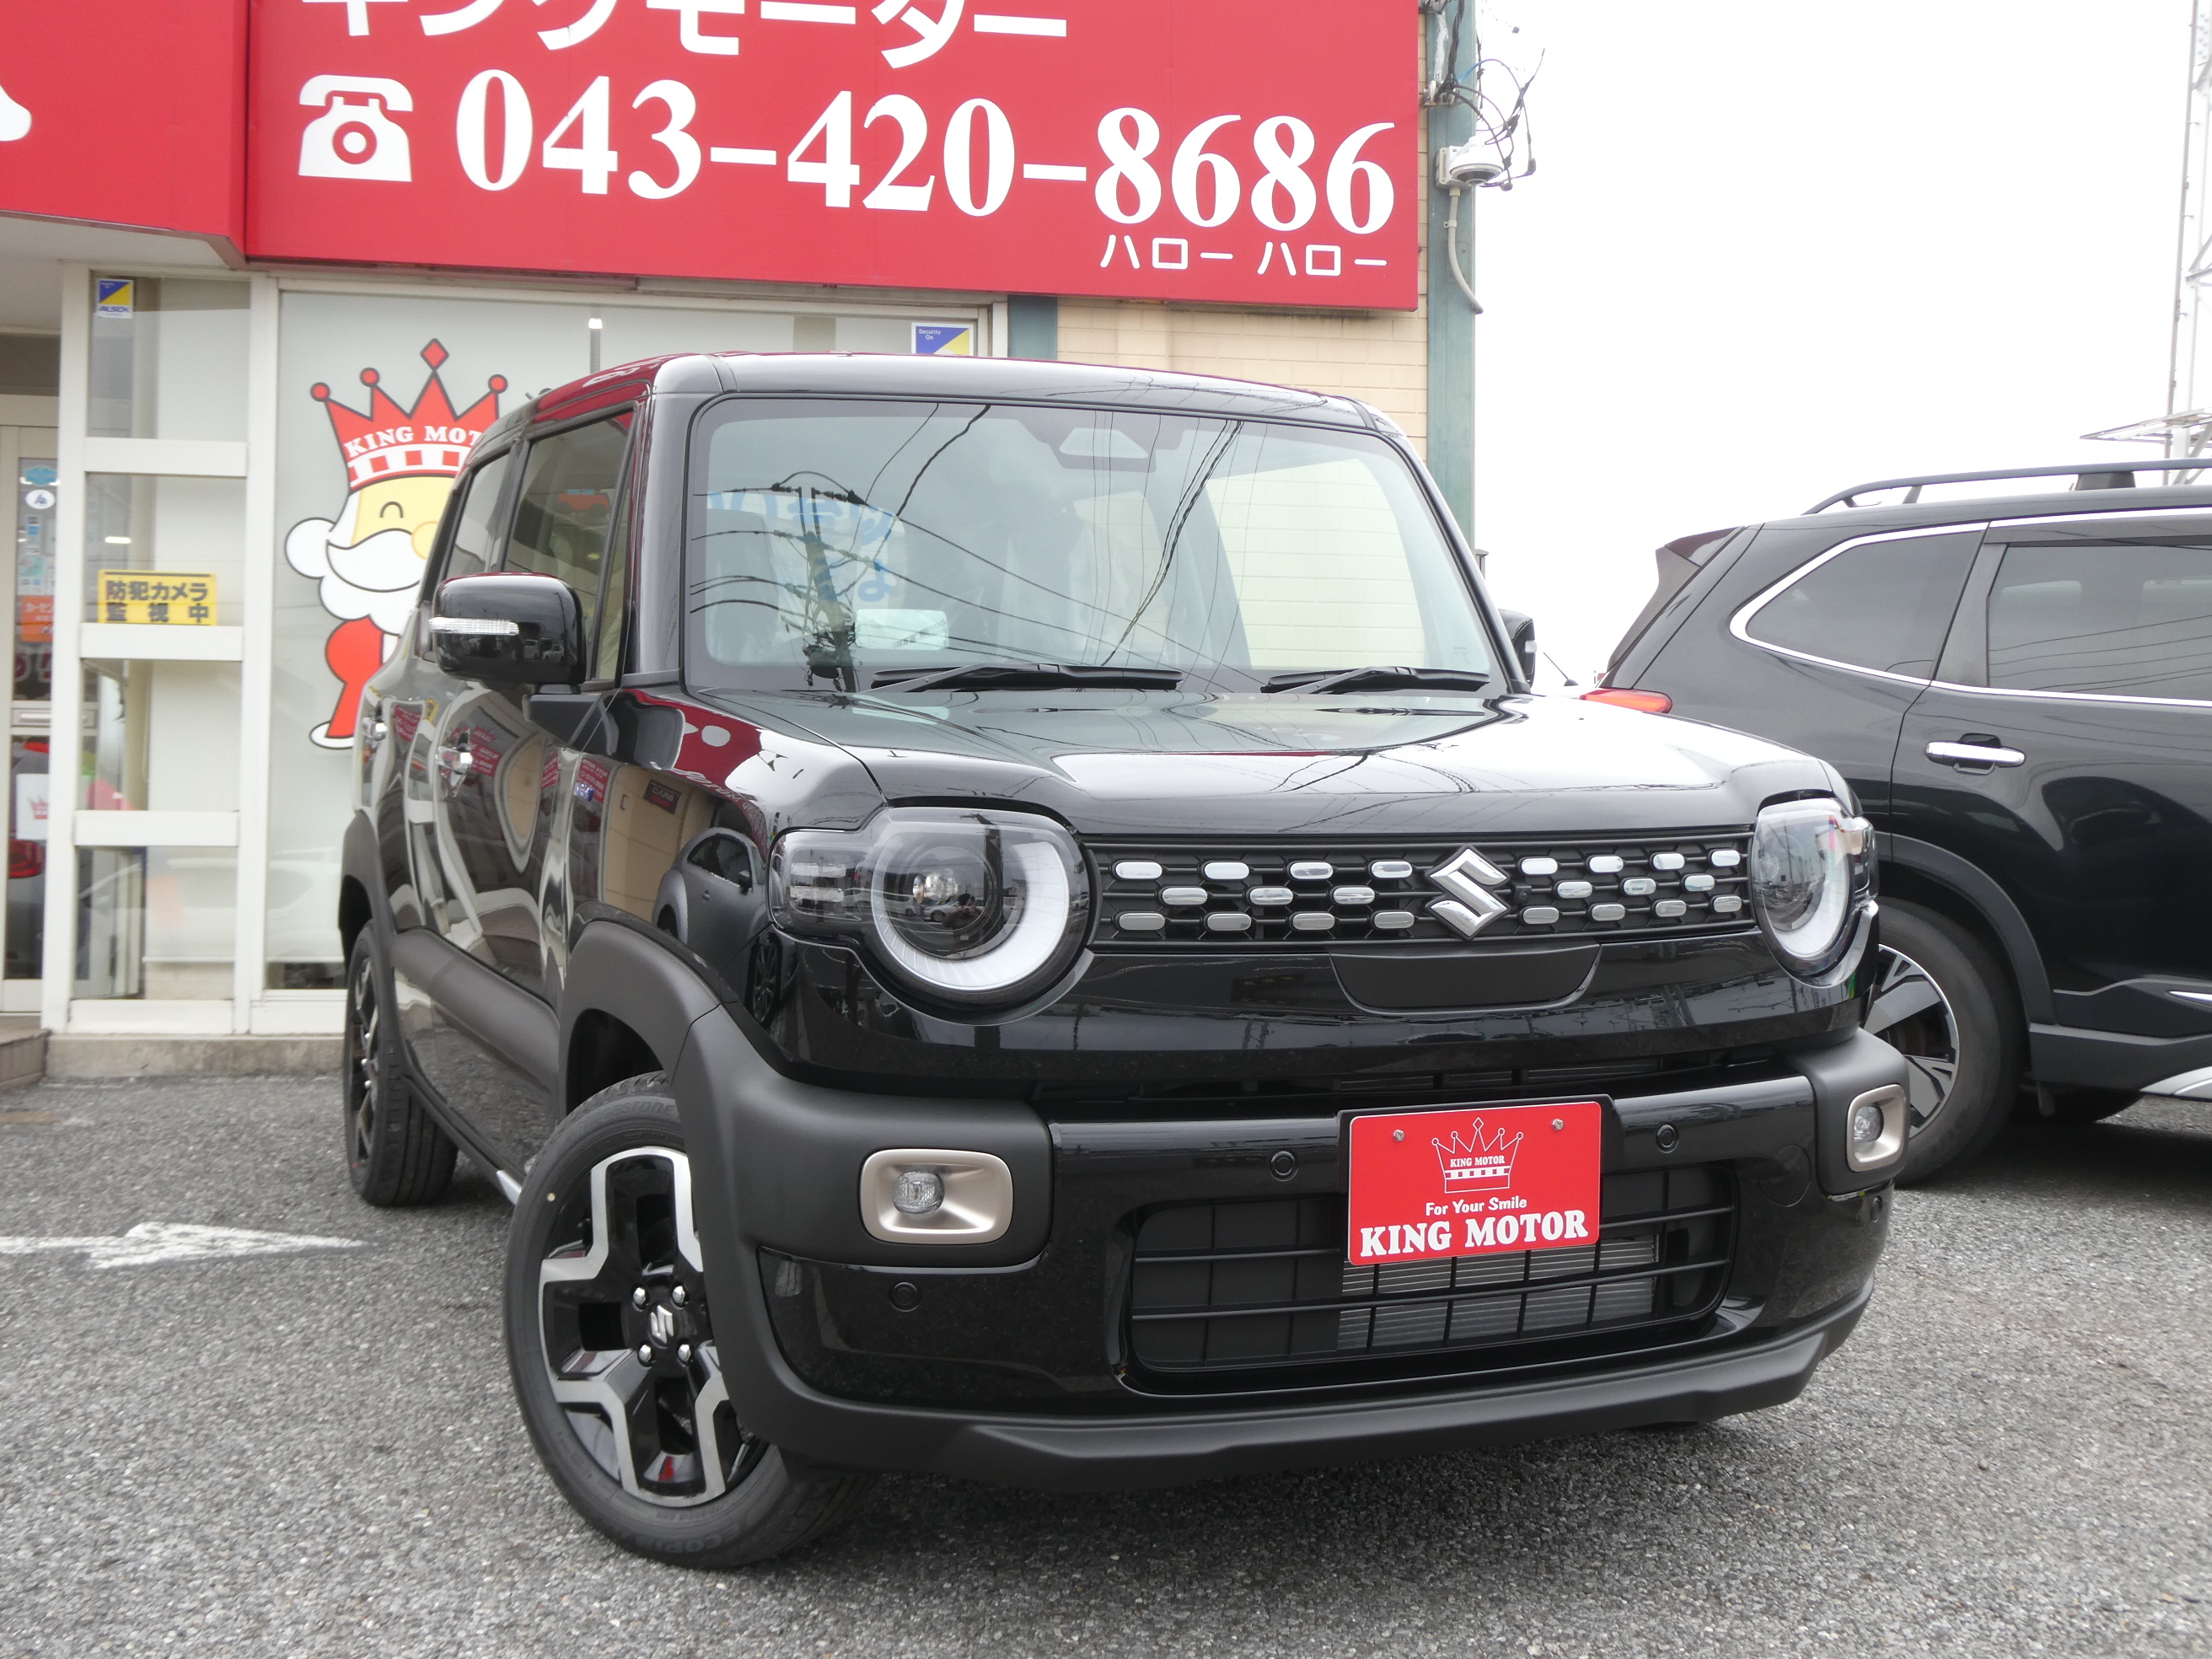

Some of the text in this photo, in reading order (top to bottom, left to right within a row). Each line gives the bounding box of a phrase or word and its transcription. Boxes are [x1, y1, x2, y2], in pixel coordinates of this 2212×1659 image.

[455, 68, 1396, 234] 043-420-8686
[1099, 234, 1388, 276] ハロー ハロー
[343, 425, 484, 459] KING MOT
[105, 580, 208, 602] 防犯カメラ
[1449, 1155, 1506, 1168] KING MOTOR
[1425, 1195, 1527, 1216] For Your Smile
[1360, 1209, 1589, 1258] KING MOTOR
